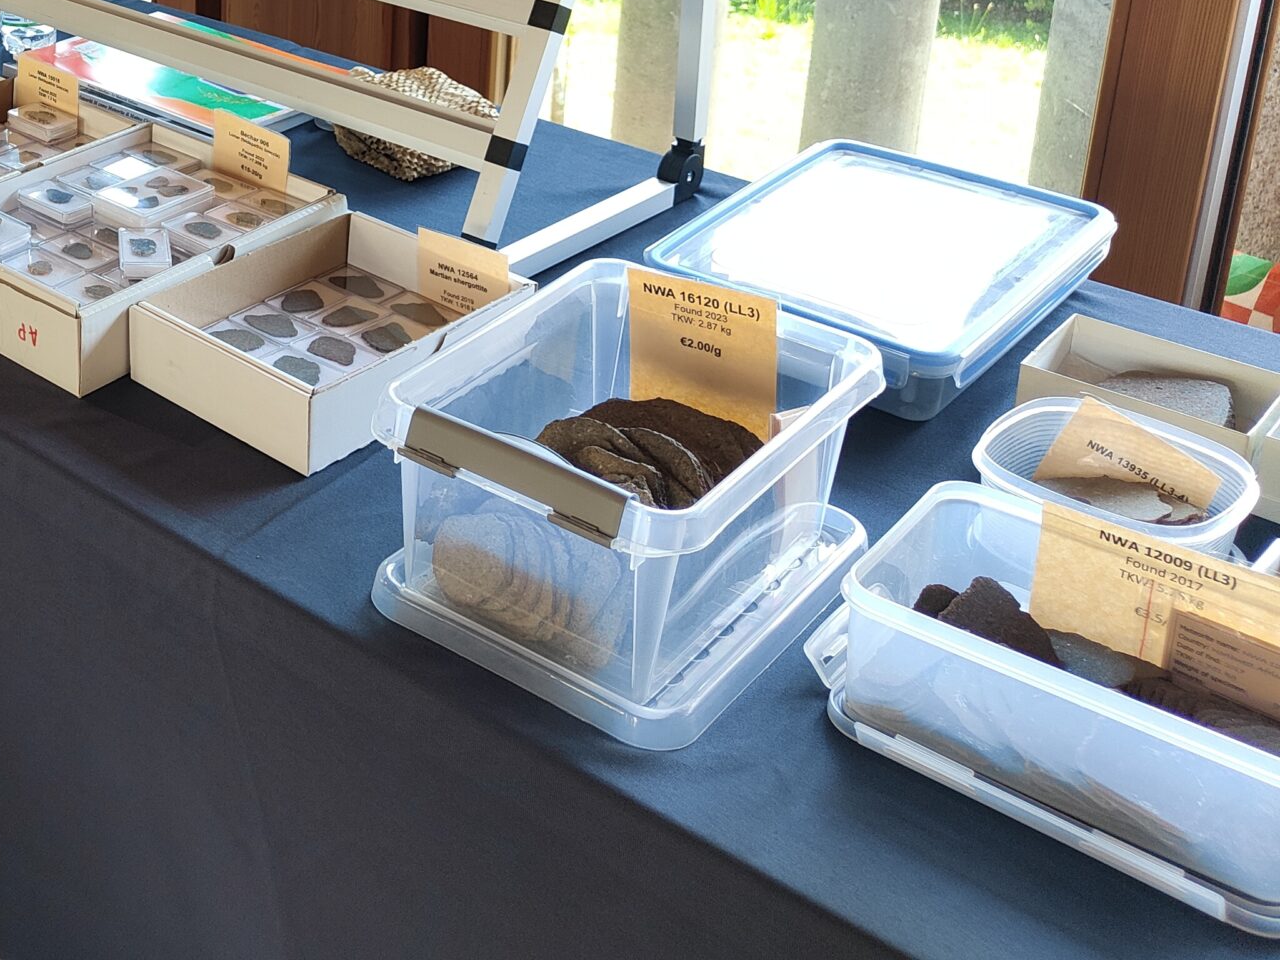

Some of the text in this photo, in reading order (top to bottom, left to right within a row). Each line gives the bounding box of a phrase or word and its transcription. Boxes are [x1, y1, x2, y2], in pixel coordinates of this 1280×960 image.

[429, 268, 452, 281] Martian
[437, 262, 455, 274] NWA
[443, 289, 460, 301] Found
[643, 282, 760, 322] NWA 16120 (LL3)
[671, 312, 732, 336] TKW: 2.87 kg
[674, 303, 728, 323] Found 2023
[680, 336, 722, 358] €2.00/g
[1087, 439, 1114, 460] NWA
[1117, 457, 1150, 480] 13935
[1099, 529, 1237, 591] NWA 12009 (LL3)
[1125, 556, 1204, 591] Found 2017
[1135, 606, 1168, 626] €3.5/
